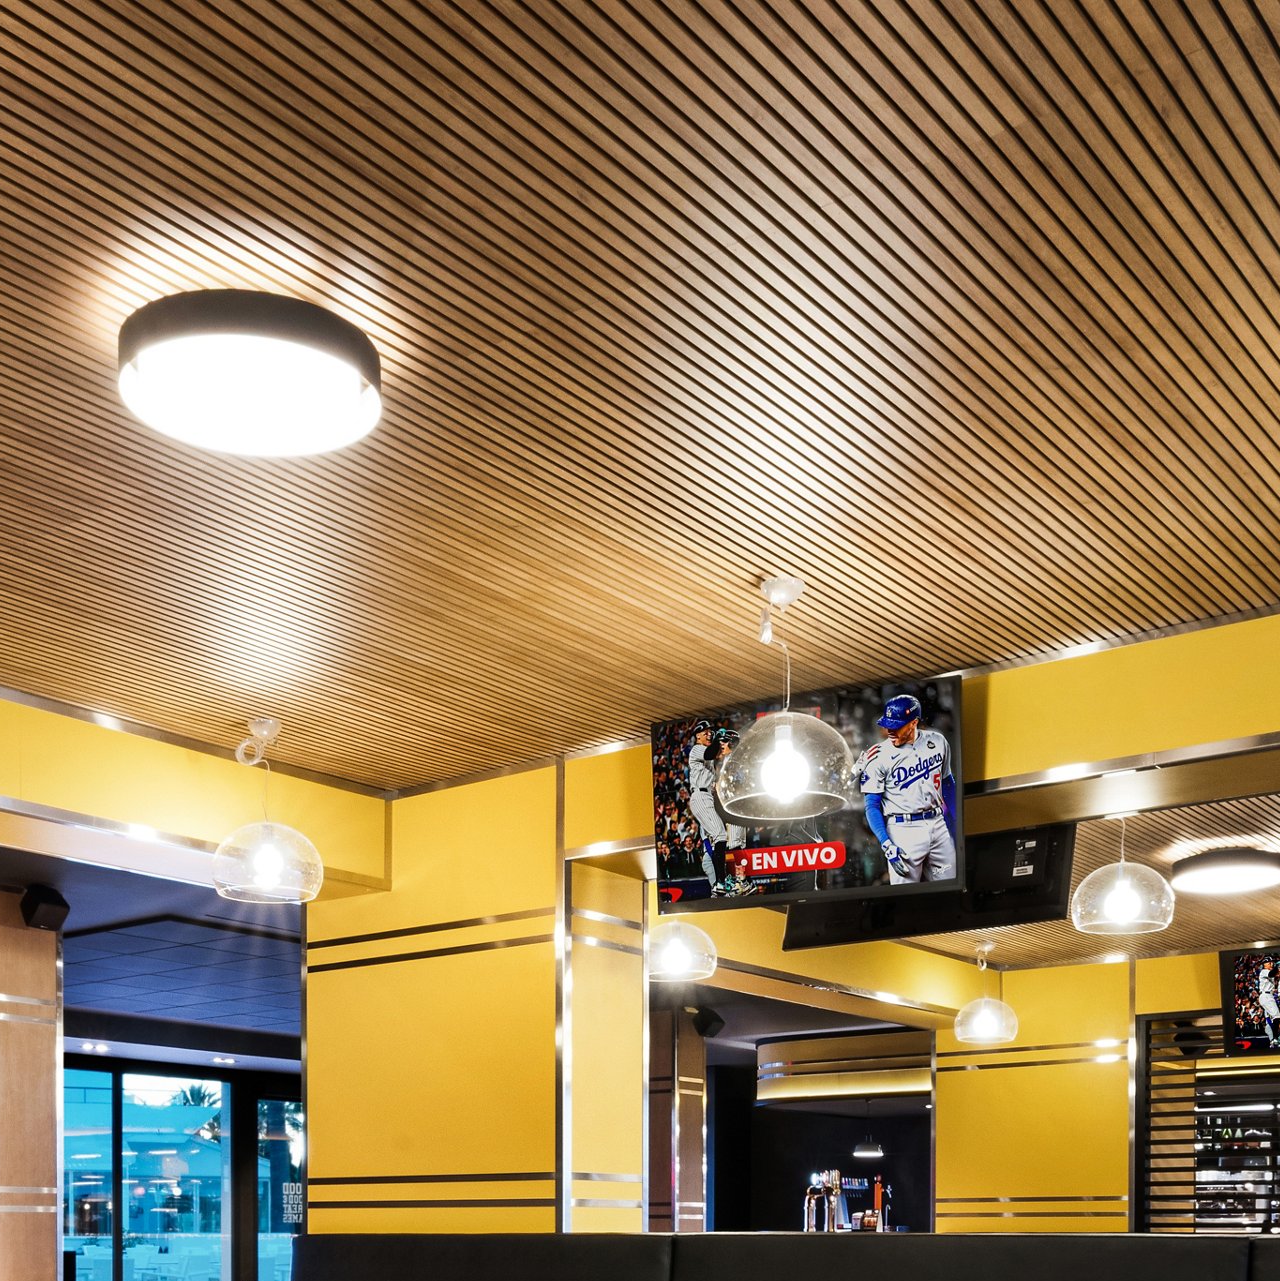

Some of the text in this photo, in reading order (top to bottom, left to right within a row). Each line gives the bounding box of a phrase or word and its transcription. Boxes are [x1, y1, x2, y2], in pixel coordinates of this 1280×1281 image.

[892, 752, 943, 787] Dodgers
[933, 774, 941, 790] 5
[752, 847, 836, 871] EN VIVO
